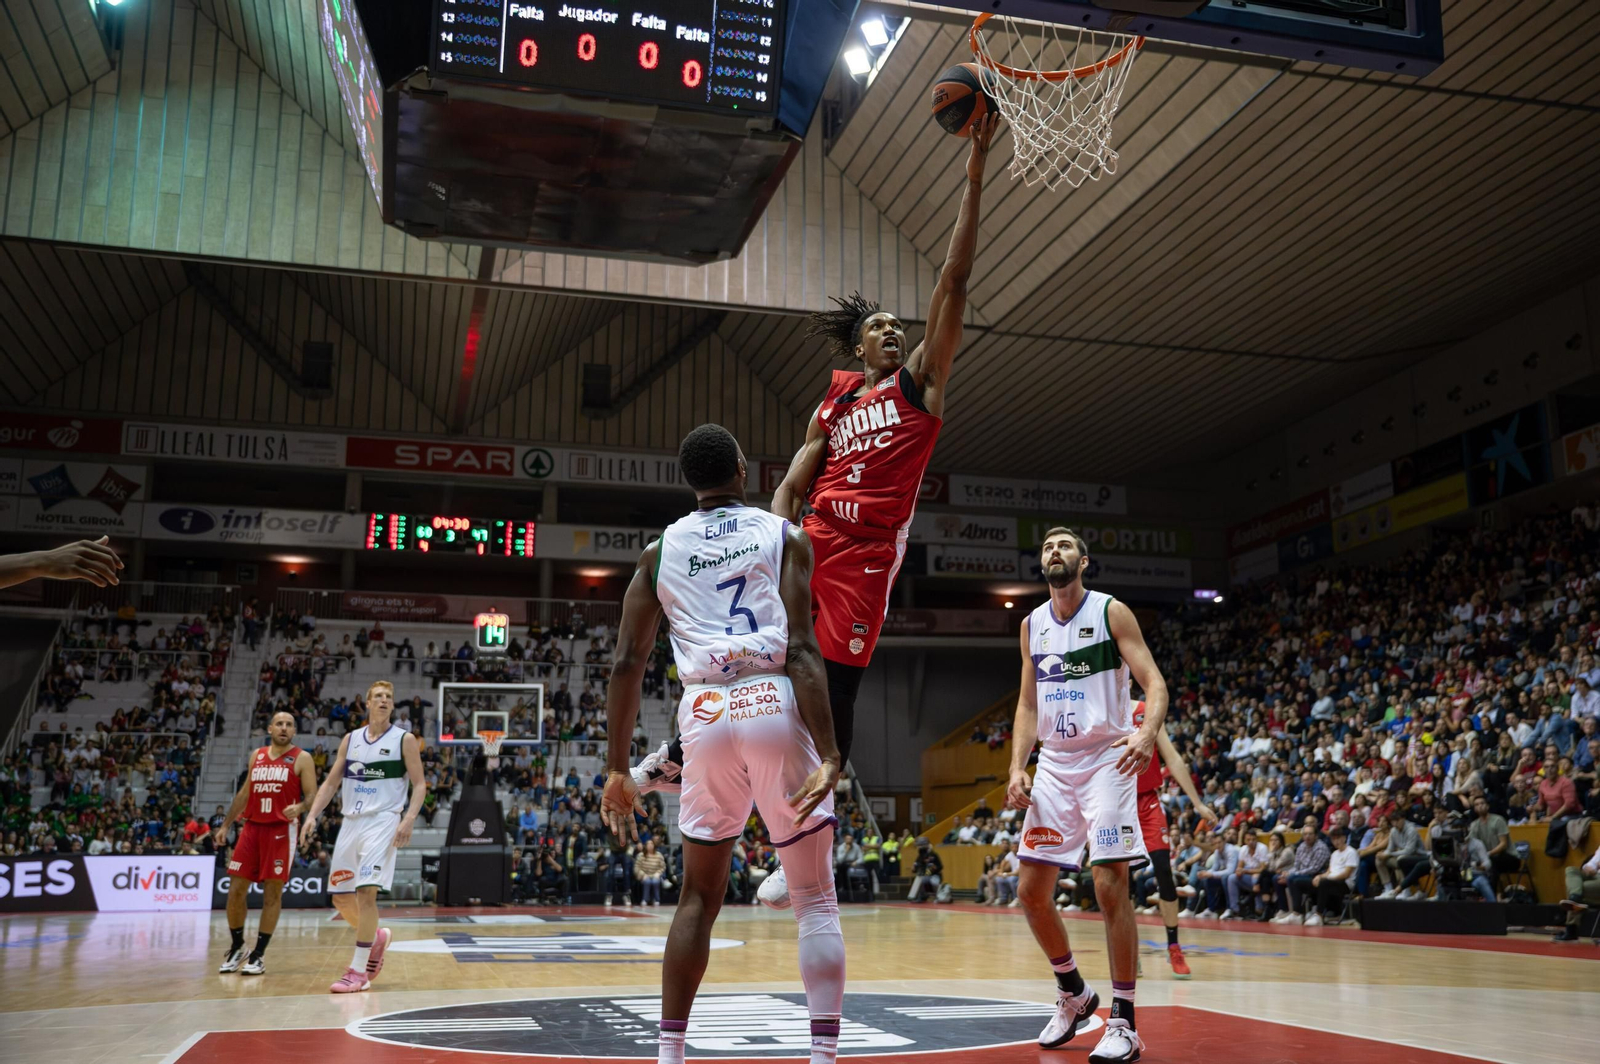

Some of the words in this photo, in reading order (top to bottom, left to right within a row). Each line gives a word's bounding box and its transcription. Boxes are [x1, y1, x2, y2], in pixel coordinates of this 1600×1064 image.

[509, 3, 545, 22] Falta
[558, 4, 619, 25] Jugador
[632, 12, 667, 31] Falta
[675, 25, 710, 43] Falta
[519, 38, 538, 67] 0
[577, 33, 597, 61] 0
[638, 41, 660, 70] 0
[682, 59, 703, 88] 0
[160, 430, 216, 457] LLEAL
[226, 433, 289, 461] TULSÀ
[394, 445, 513, 471] SPAR
[598, 458, 647, 482] LLEAL
[847, 463, 866, 484] 5
[40, 475, 63, 491] ibis
[101, 478, 128, 500] ibis
[35, 513, 76, 524] HOTEL
[79, 515, 125, 527] GIRONA
[222, 508, 342, 534] infoself
[705, 518, 738, 540] EJIM
[219, 529, 265, 542] group
[416, 525, 433, 538] 60
[446, 529, 456, 542] 3
[471, 528, 488, 542] 47
[716, 575, 759, 636] 3
[486, 625, 505, 644] 14
[729, 681, 779, 699] COSTA
[729, 697, 754, 711] DEL
[756, 694, 782, 706] SOL
[730, 703, 784, 723] MÁLAGA
[1056, 713, 1078, 739] 45
[251, 766, 290, 782] GIRONA
[363, 767, 385, 778] Unicaja
[253, 783, 283, 793] FIATC
[260, 798, 272, 813] 10
[112, 866, 200, 890] divina
[153, 892, 199, 904] seguros
